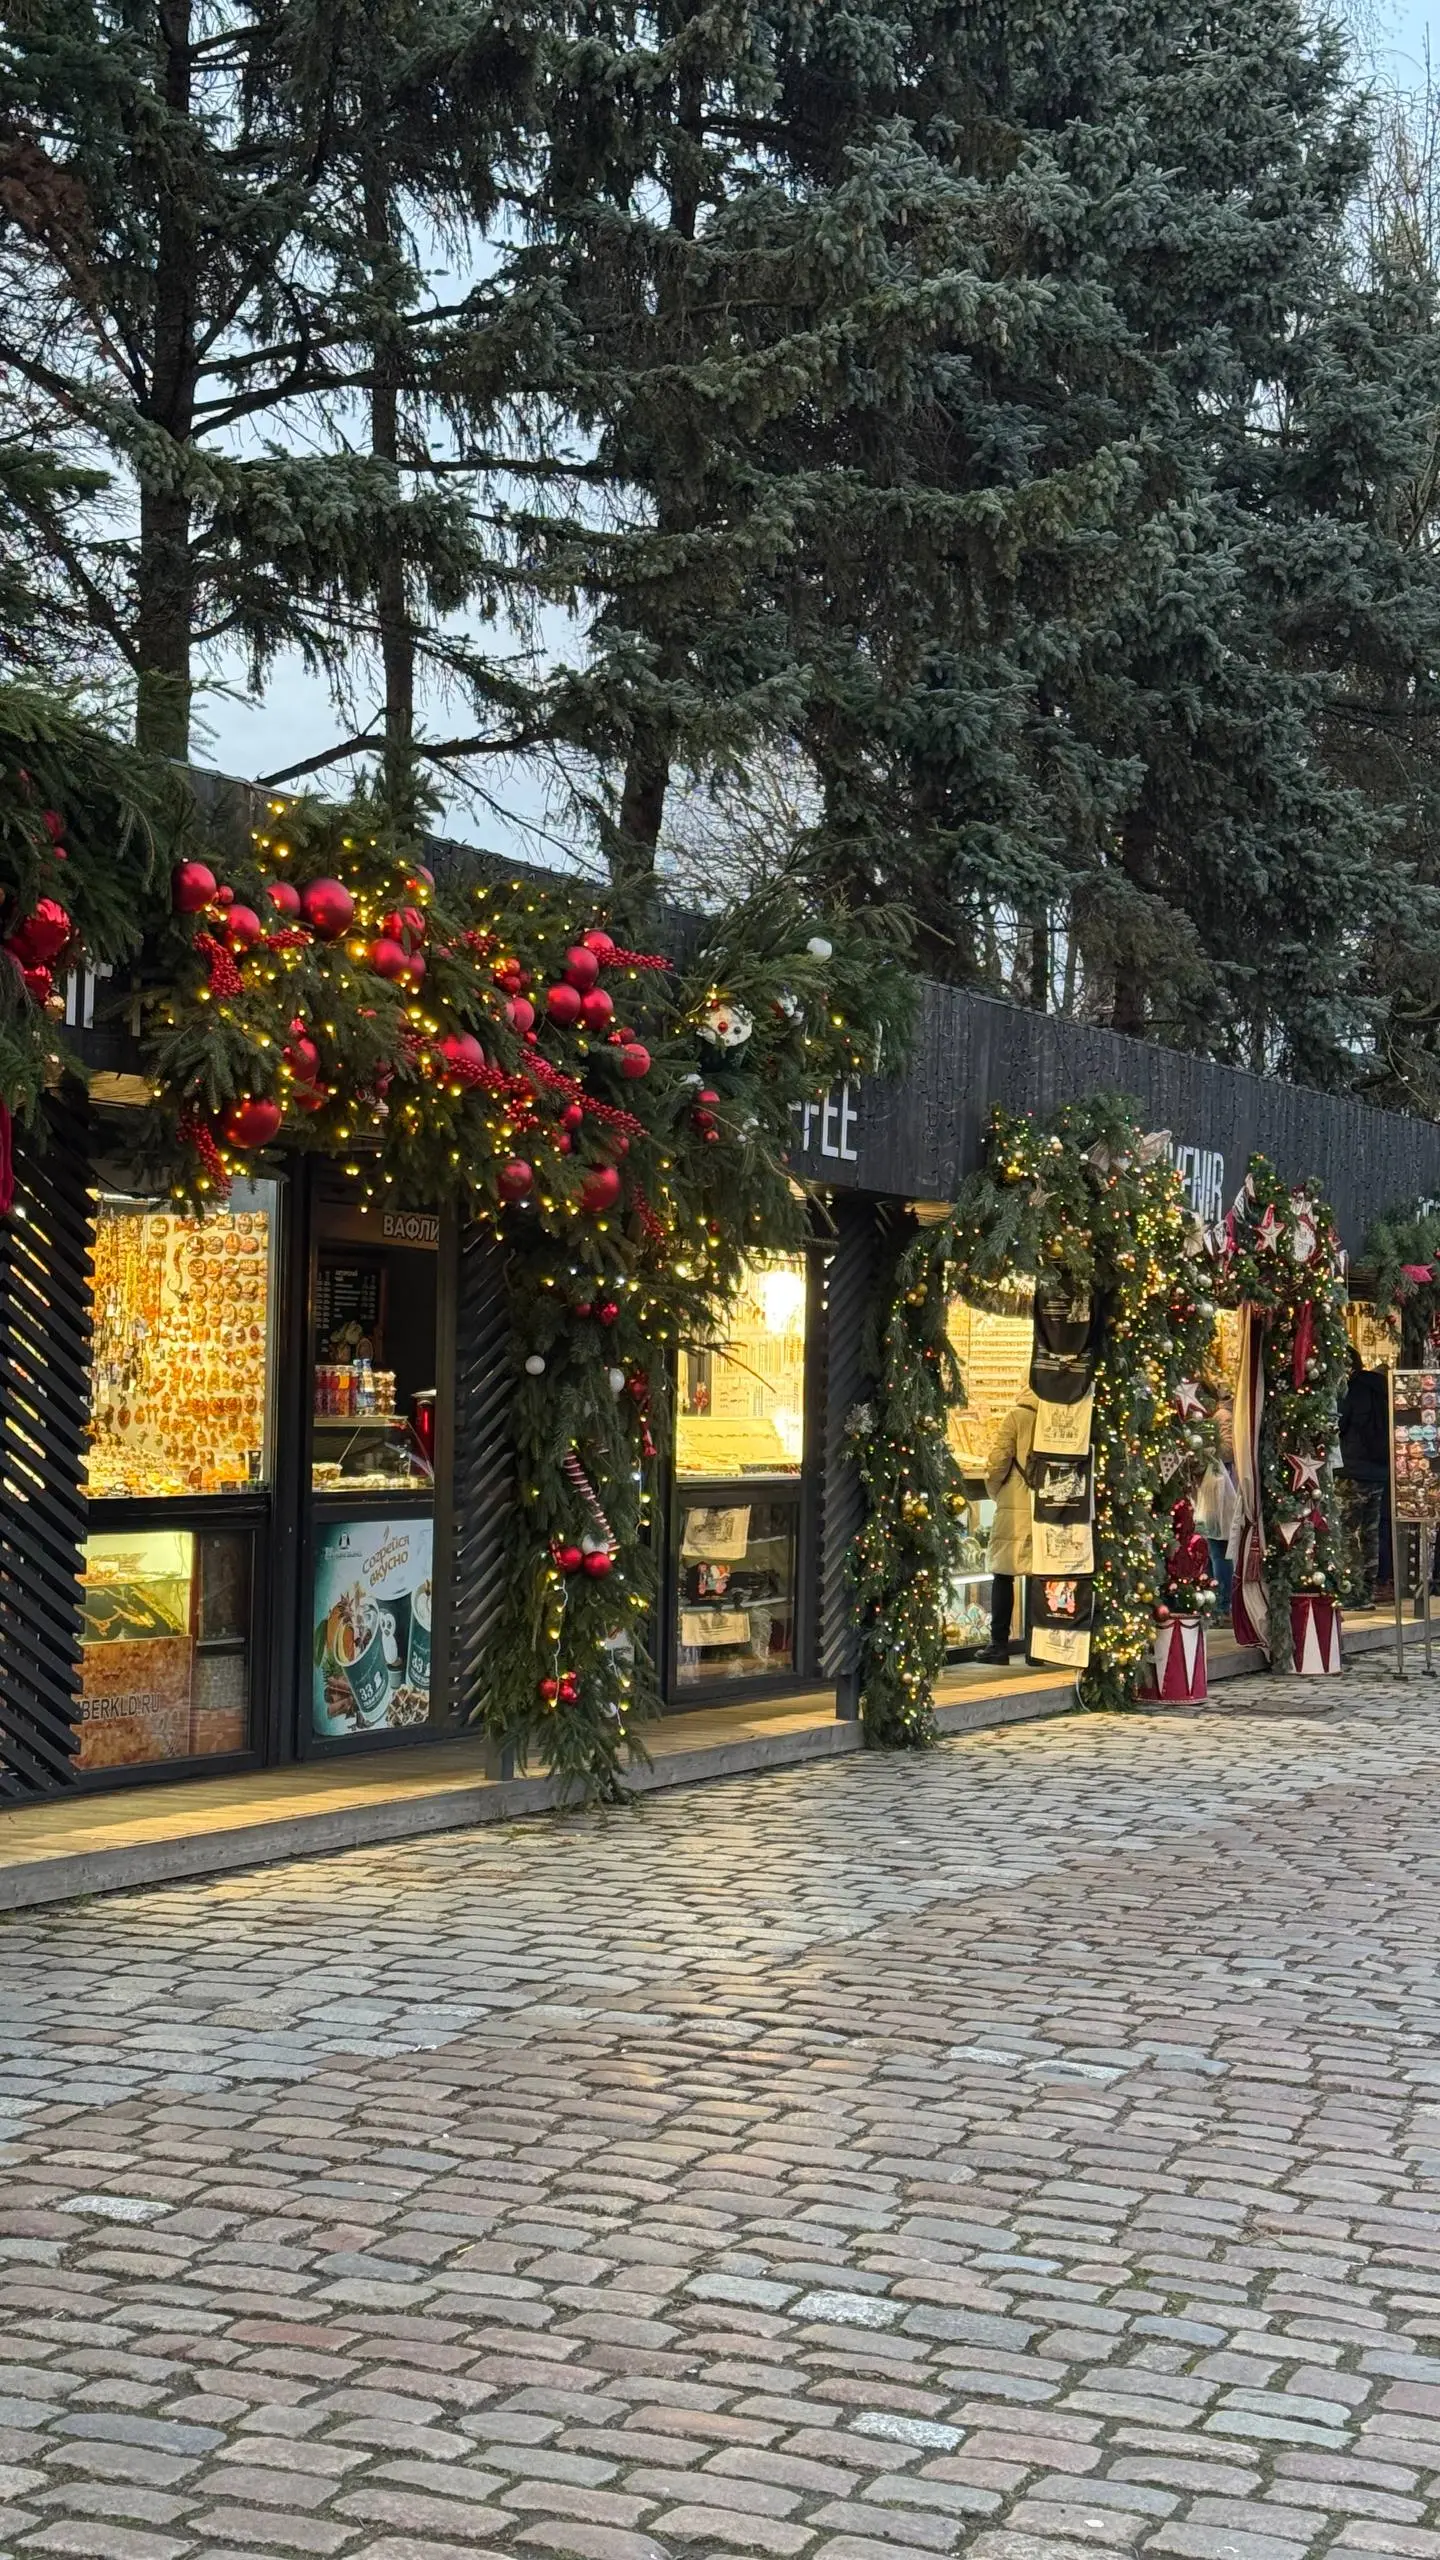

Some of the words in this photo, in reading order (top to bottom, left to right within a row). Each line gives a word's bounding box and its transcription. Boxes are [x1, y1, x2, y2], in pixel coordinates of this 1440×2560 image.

[383, 1214, 440, 1242] ВАФЛИ
[359, 1683, 374, 1702] 33
[79, 1693, 161, 1720] BERKLD.RU
